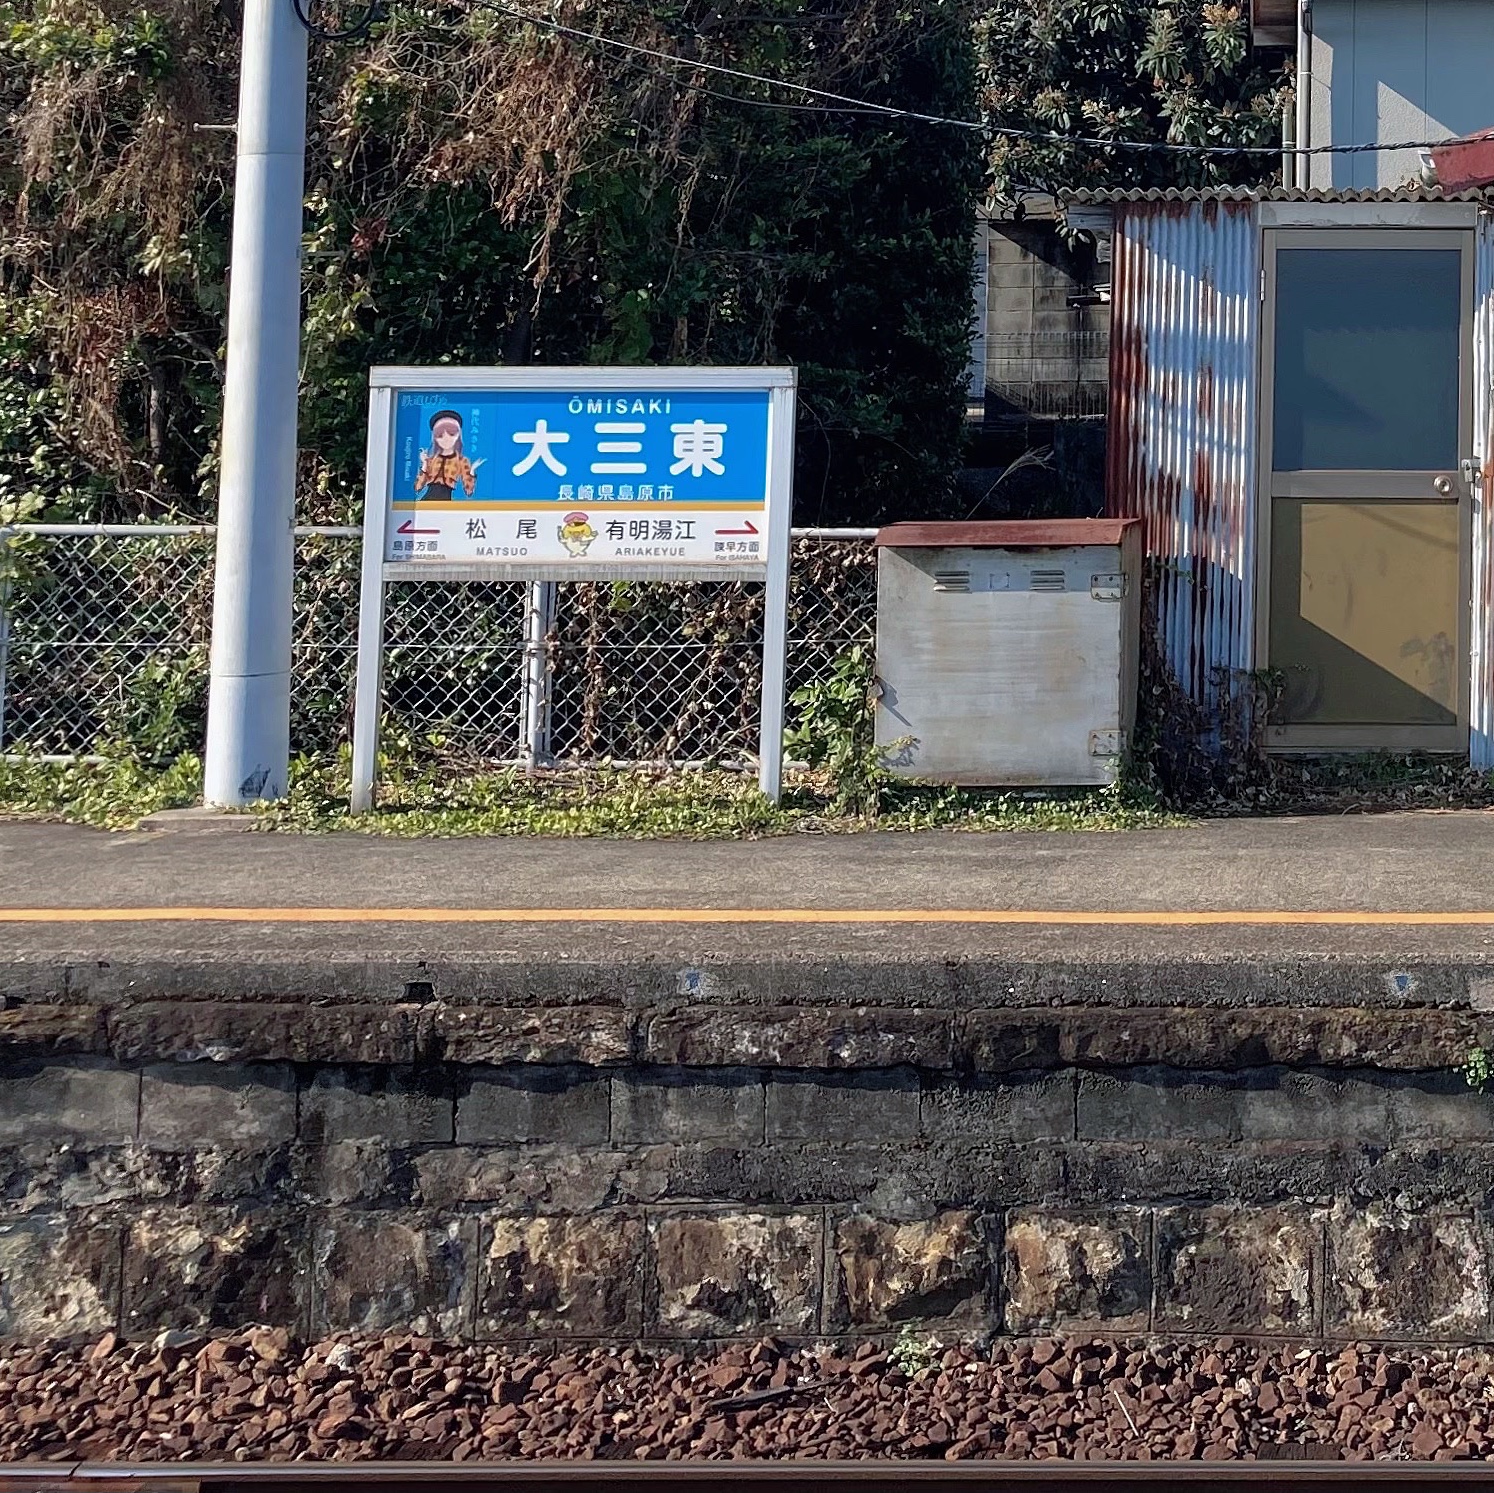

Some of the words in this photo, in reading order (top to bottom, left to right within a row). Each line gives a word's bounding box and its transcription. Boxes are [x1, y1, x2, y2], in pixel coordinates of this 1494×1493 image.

[512, 419, 728, 477] 大三東
[557, 484, 675, 501] 長崎県島原市
[605, 519, 696, 541] 有明湯江
[392, 540, 438, 552] 島原方面
[476, 547, 528, 556] MATSUO
[615, 547, 686, 556] ARIAKEYUE
